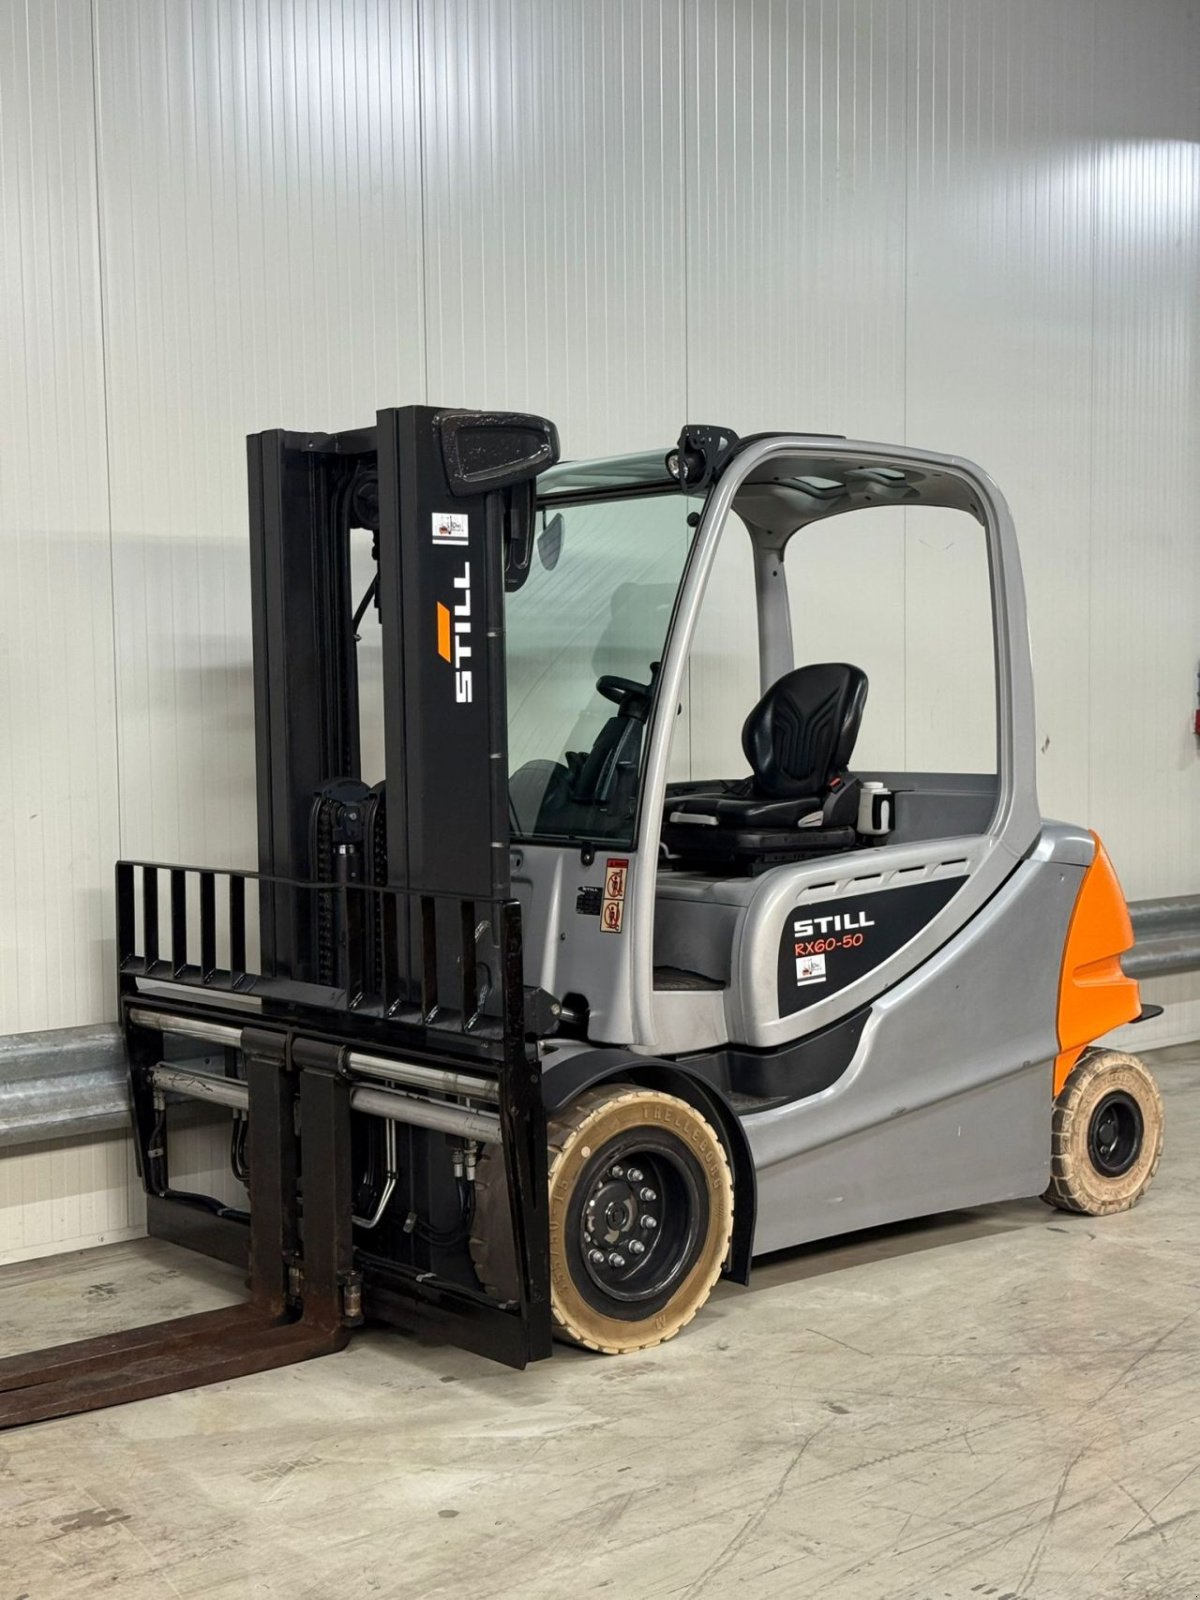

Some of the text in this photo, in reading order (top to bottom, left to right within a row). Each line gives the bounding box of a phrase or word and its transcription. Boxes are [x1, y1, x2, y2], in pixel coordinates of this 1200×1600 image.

[453, 561, 472, 703] STILL
[793, 911, 875, 938] STILL
[794, 933, 863, 956] RX60-50
[641, 1105, 723, 1190] TRELLEBORG
